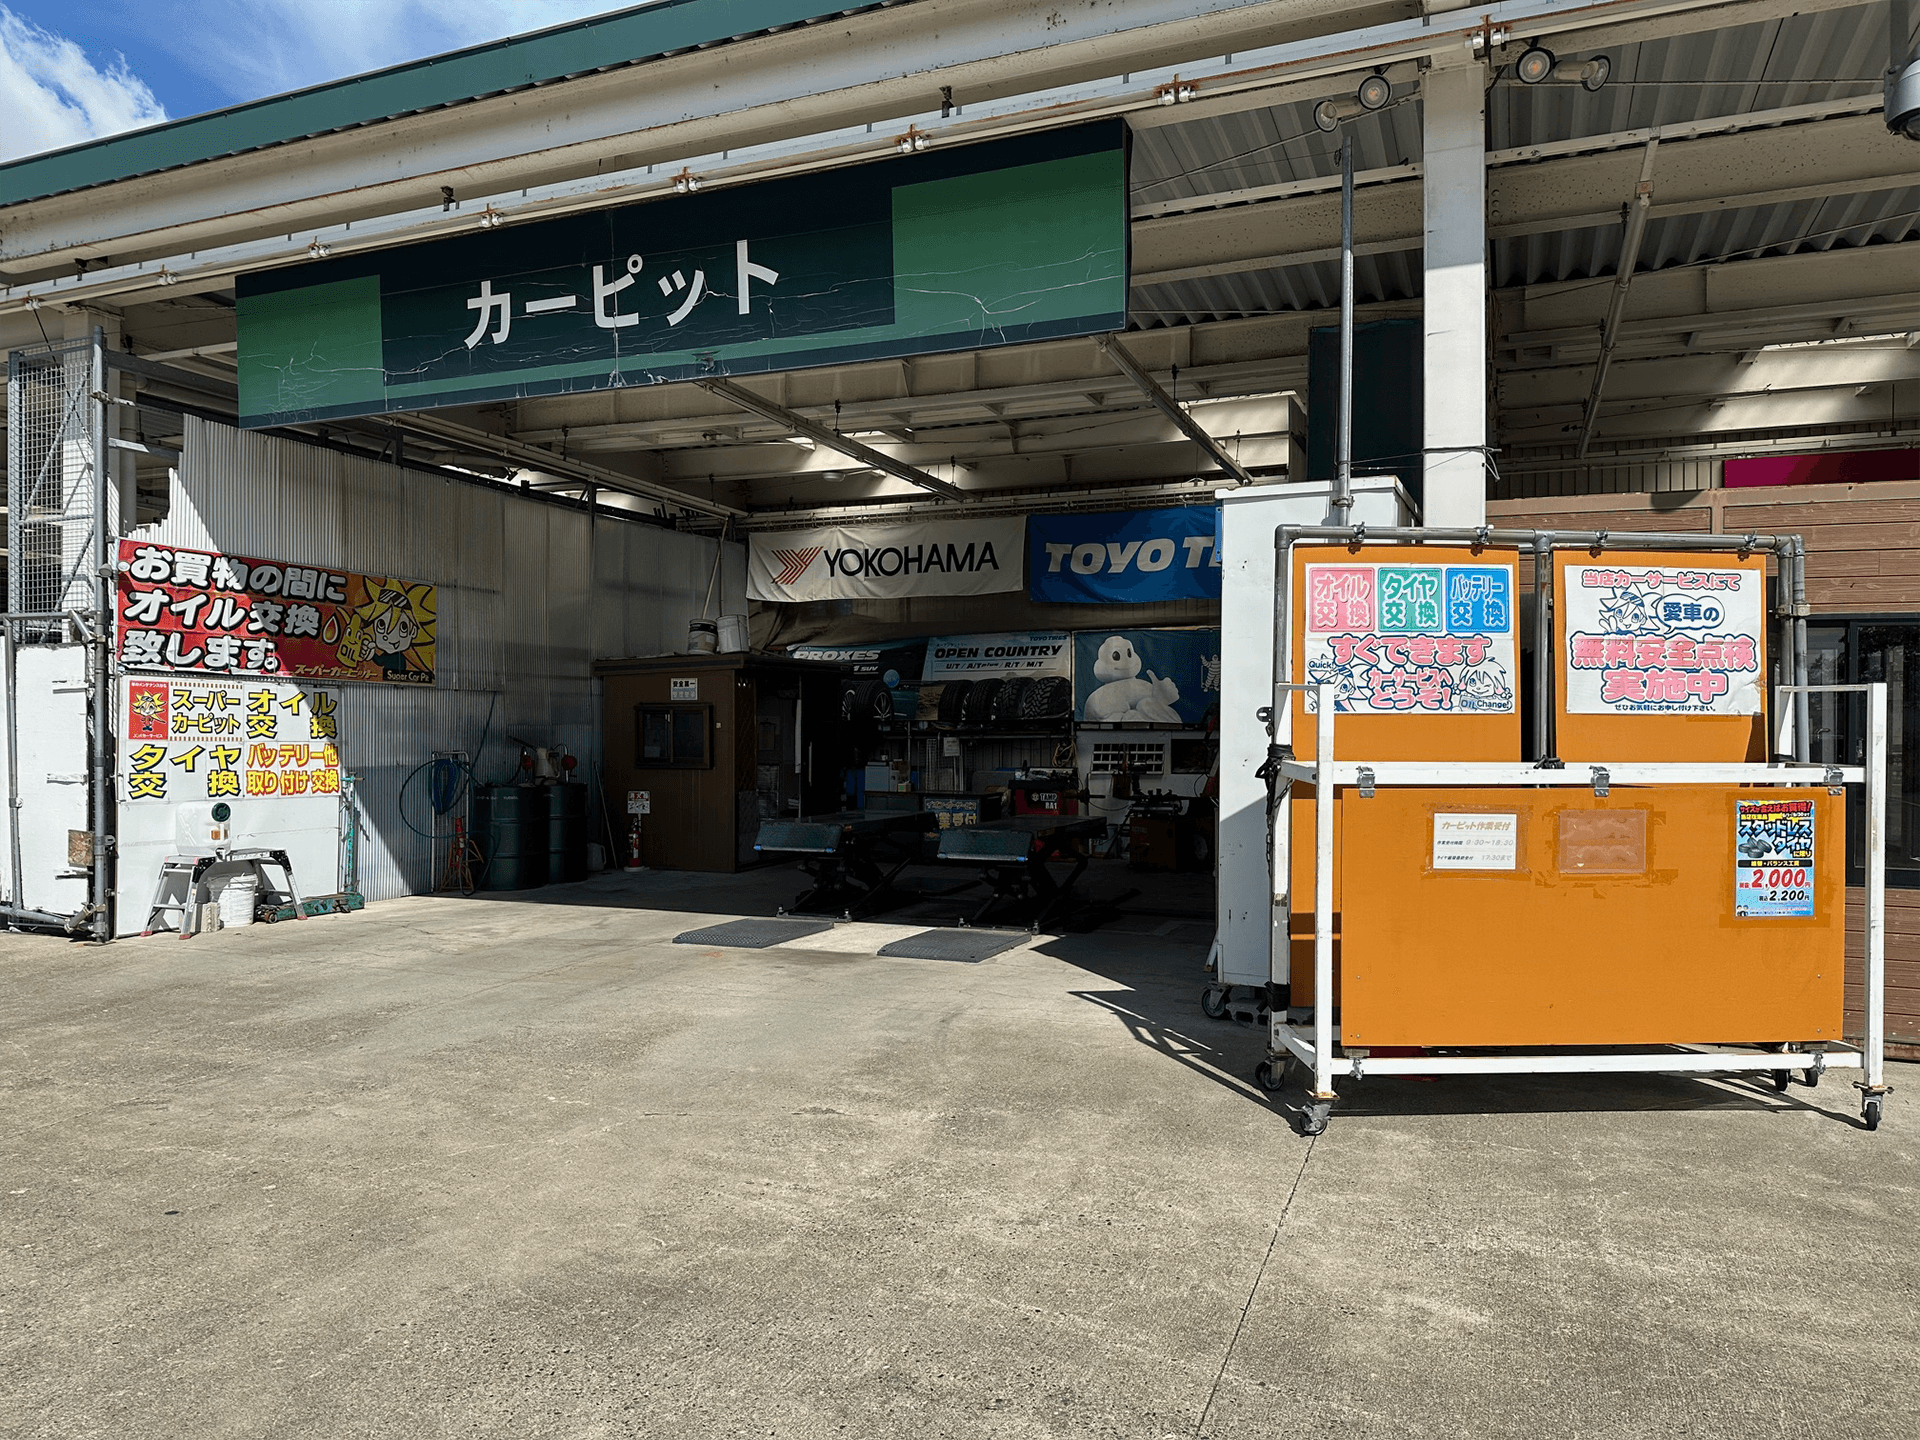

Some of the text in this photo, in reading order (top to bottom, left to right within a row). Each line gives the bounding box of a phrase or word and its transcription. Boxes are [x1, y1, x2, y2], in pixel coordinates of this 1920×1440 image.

[464, 239, 779, 349] カーピット
[823, 541, 1000, 578] YOKOHAMA
[1046, 538, 1175, 574] TOYO
[130, 546, 348, 602] お買物の間に
[1315, 574, 1370, 600] オイル
[1451, 574, 1504, 600] バッテリー
[1583, 571, 1741, 590] 当店カーサービスにて
[1384, 574, 1437, 601] タイヤ
[124, 588, 320, 636] オイル交換
[1663, 602, 1720, 622] 愛車の
[120, 628, 279, 671] 致します。
[340, 644, 357, 662] OIL
[934, 645, 1063, 659] OPEN COUNTRY
[1328, 635, 1490, 665] すぐできます
[1573, 635, 1756, 671] 無料安全点検
[387, 671, 407, 681] Super
[1308, 660, 1334, 670] Quick!
[1369, 668, 1453, 687] カーサービスへ
[1603, 669, 1727, 702] 実施中
[171, 689, 241, 711] スーパー
[246, 689, 338, 716] オイル
[1476, 699, 1510, 709] Change!
[1614, 704, 1716, 712] ぜひお気軽にお申し付け下さい。
[171, 712, 241, 734] カーピット
[129, 744, 241, 772] タイヤ
[247, 743, 339, 768] バッテリー他
[246, 769, 340, 795] 取り付け交換
[1738, 820, 1812, 837] スタッドレス
[1773, 837, 1812, 855] タイヤ
